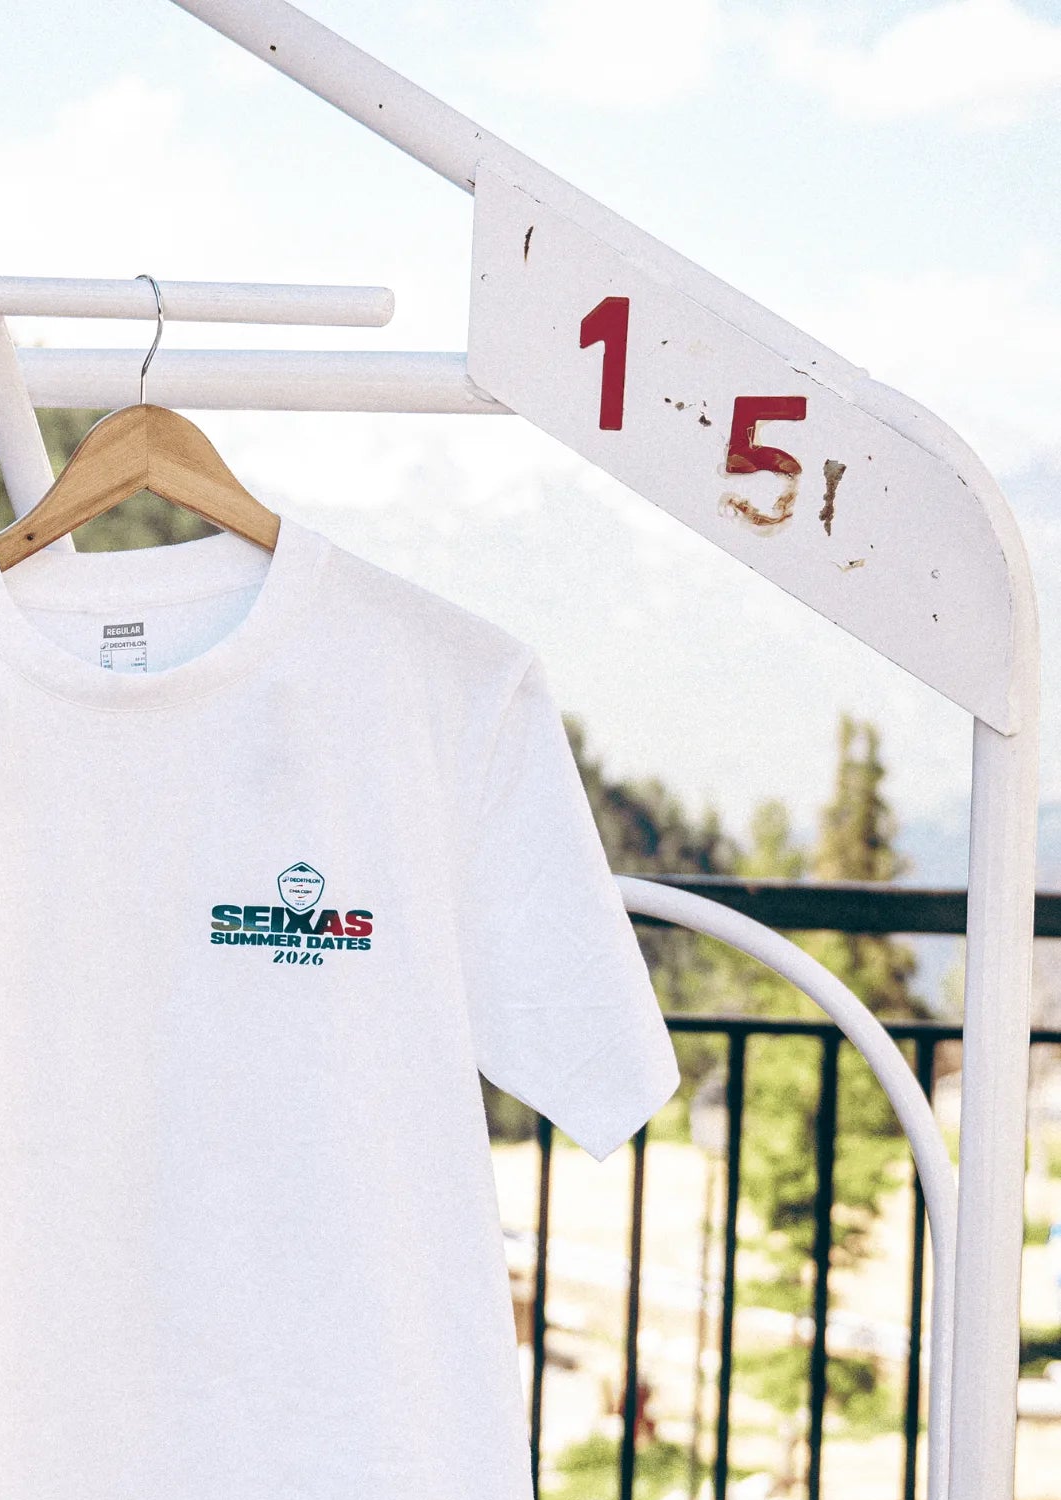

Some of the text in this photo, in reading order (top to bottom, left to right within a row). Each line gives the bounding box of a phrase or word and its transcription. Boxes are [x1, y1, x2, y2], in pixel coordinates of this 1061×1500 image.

[106, 625, 141, 636] REGULAR
[109, 640, 147, 649] DECATHLON
[210, 904, 374, 937] SEIXAS
[210, 932, 372, 951] SUMMER DATES
[272, 950, 324, 966] 2026
